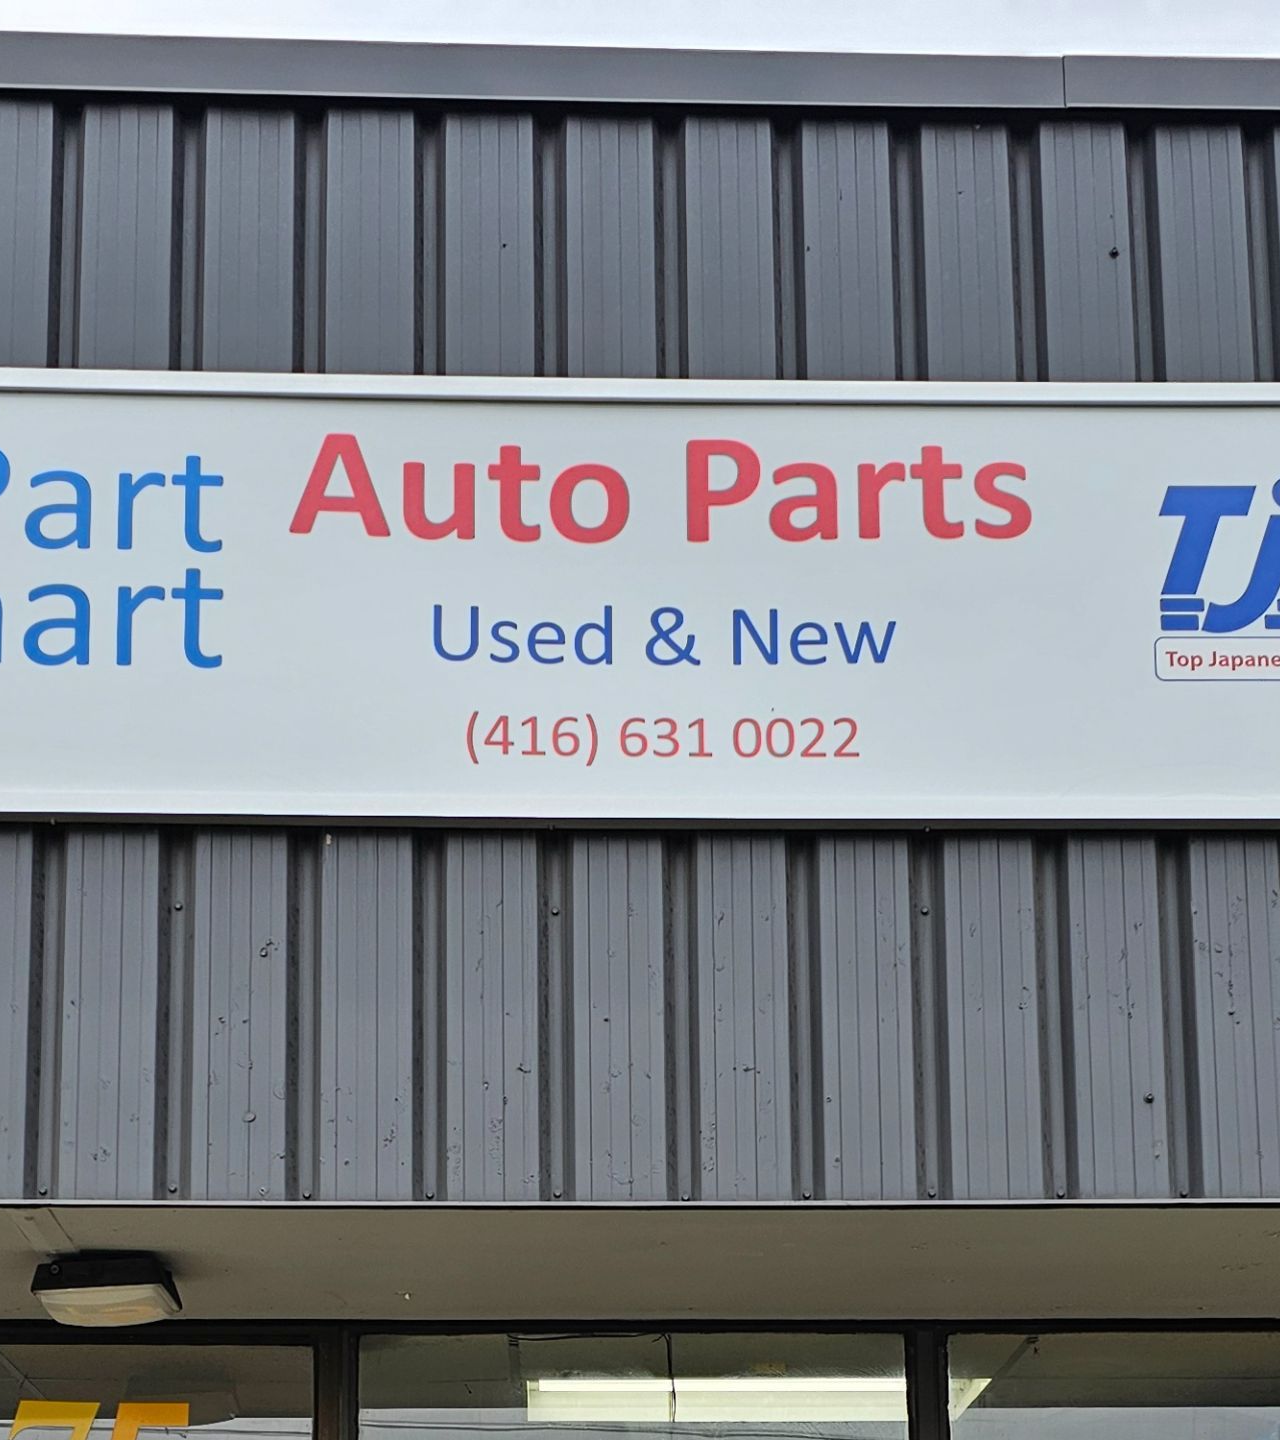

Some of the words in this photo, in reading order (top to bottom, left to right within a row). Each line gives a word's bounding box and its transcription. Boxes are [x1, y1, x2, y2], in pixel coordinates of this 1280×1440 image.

[289, 432, 630, 545] Auto
[684, 438, 1033, 545] Parts
[432, 603, 614, 666] Used
[645, 606, 701, 666] &
[732, 608, 897, 666] New
[1165, 651, 1203, 671] Top
[465, 711, 600, 766] (416)
[618, 717, 714, 759] 631
[732, 717, 861, 760] 0022
